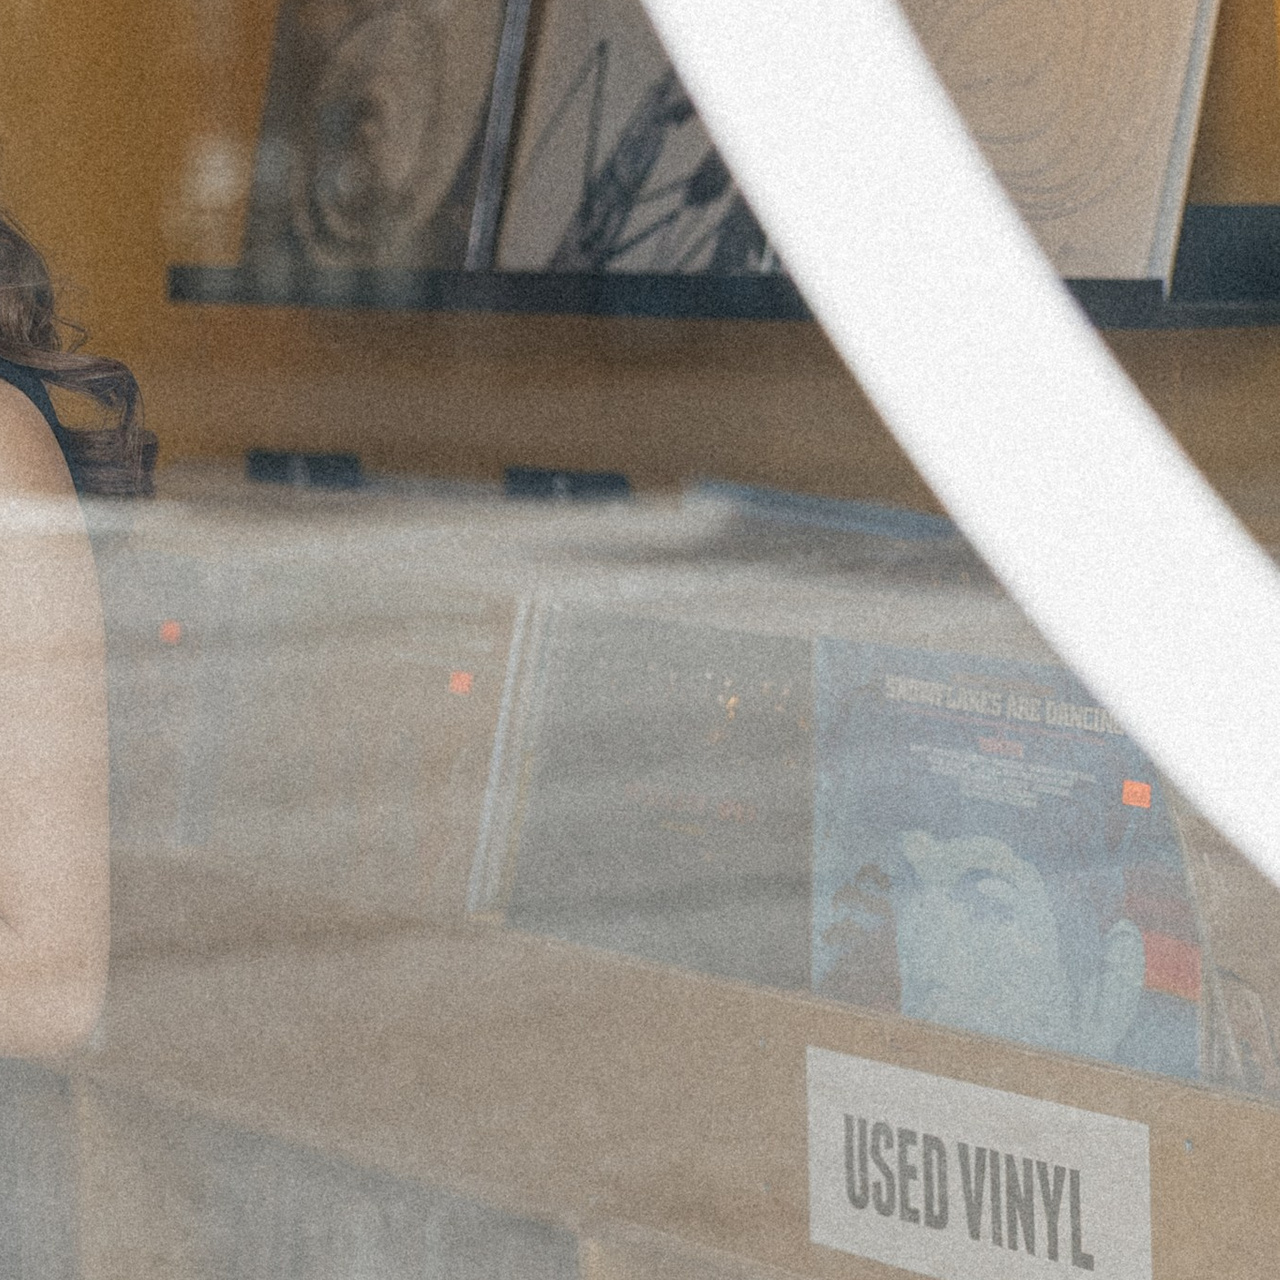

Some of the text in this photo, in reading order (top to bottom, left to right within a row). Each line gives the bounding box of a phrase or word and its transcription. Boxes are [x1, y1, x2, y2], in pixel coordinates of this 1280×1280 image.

[1007, 693, 1040, 722] ARE
[844, 1113, 1095, 1272] USED VINYL
